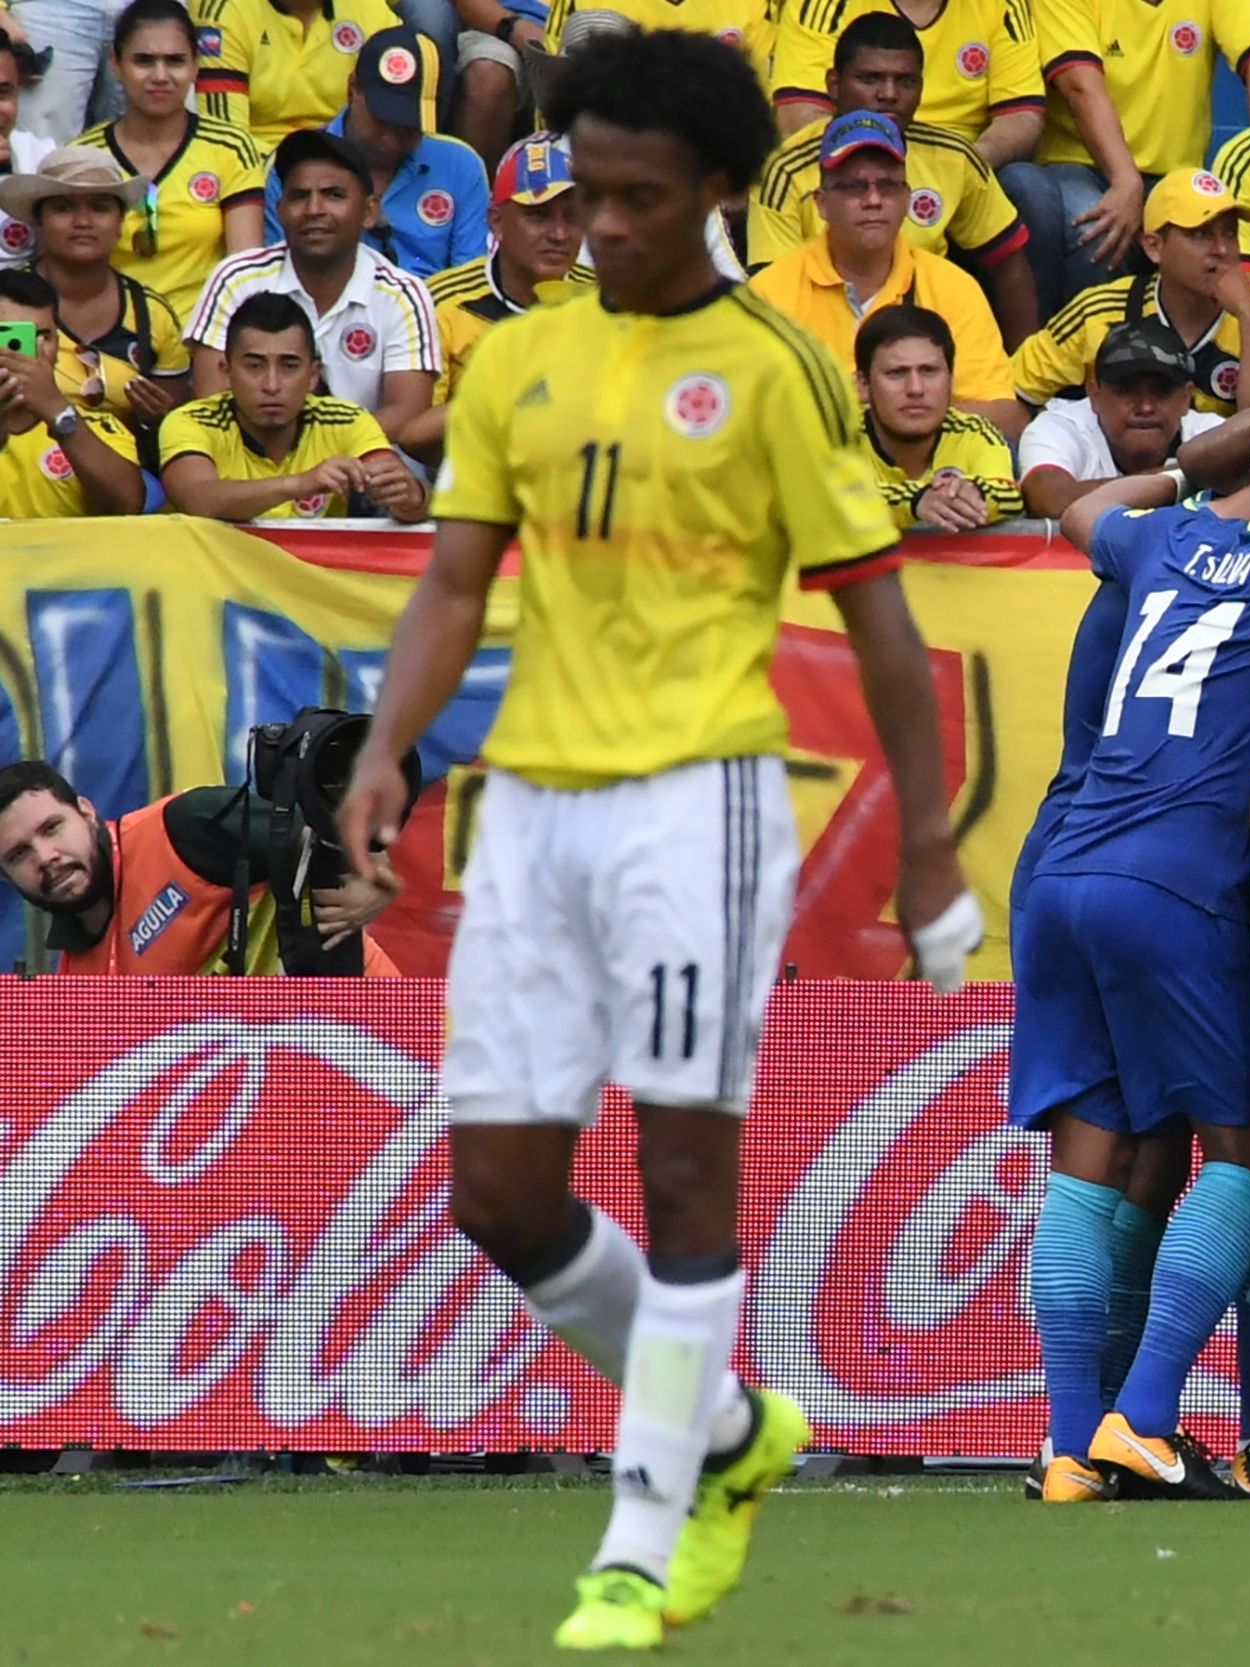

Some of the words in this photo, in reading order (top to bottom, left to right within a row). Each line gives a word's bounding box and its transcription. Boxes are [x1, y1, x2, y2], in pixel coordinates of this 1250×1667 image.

[576, 441, 621, 541] 11
[1102, 590, 1247, 738] 14
[131, 887, 184, 952] AGUILA
[651, 963, 698, 1060] 11
